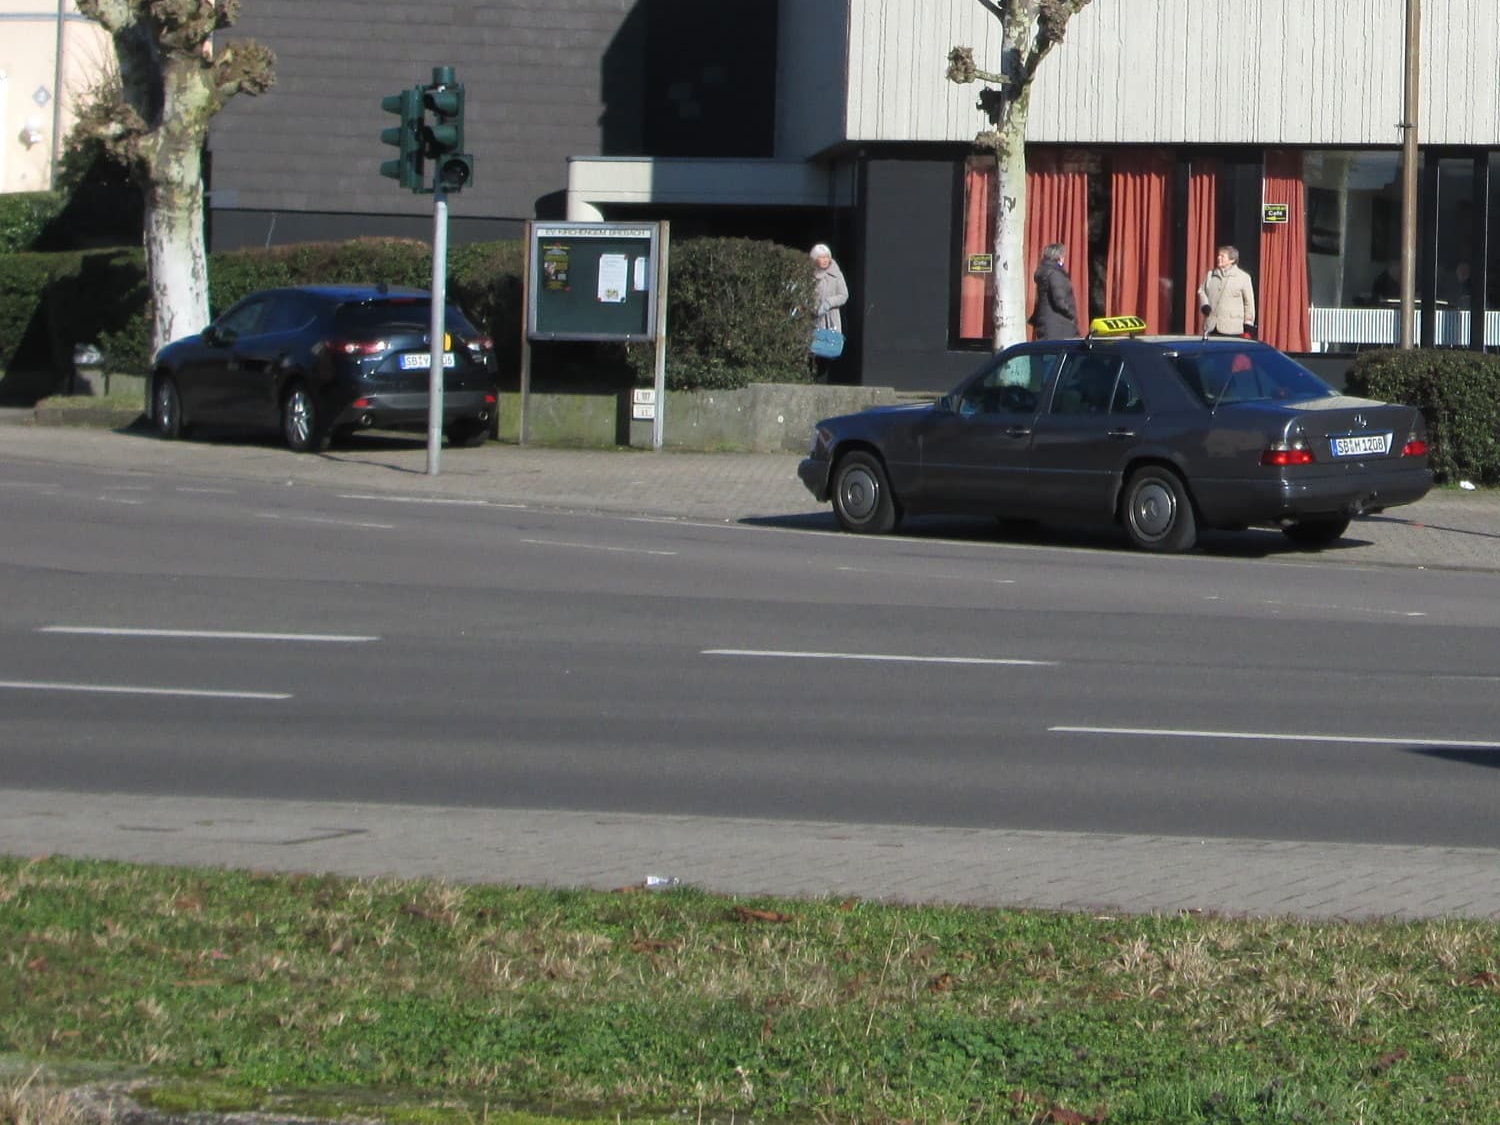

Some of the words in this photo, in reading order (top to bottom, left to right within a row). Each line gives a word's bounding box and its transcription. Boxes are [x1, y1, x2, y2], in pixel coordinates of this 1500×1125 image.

[1106, 318, 1139, 329] TAXI
[1338, 440, 1350, 453] SB
[1362, 438, 1384, 451] 1208
